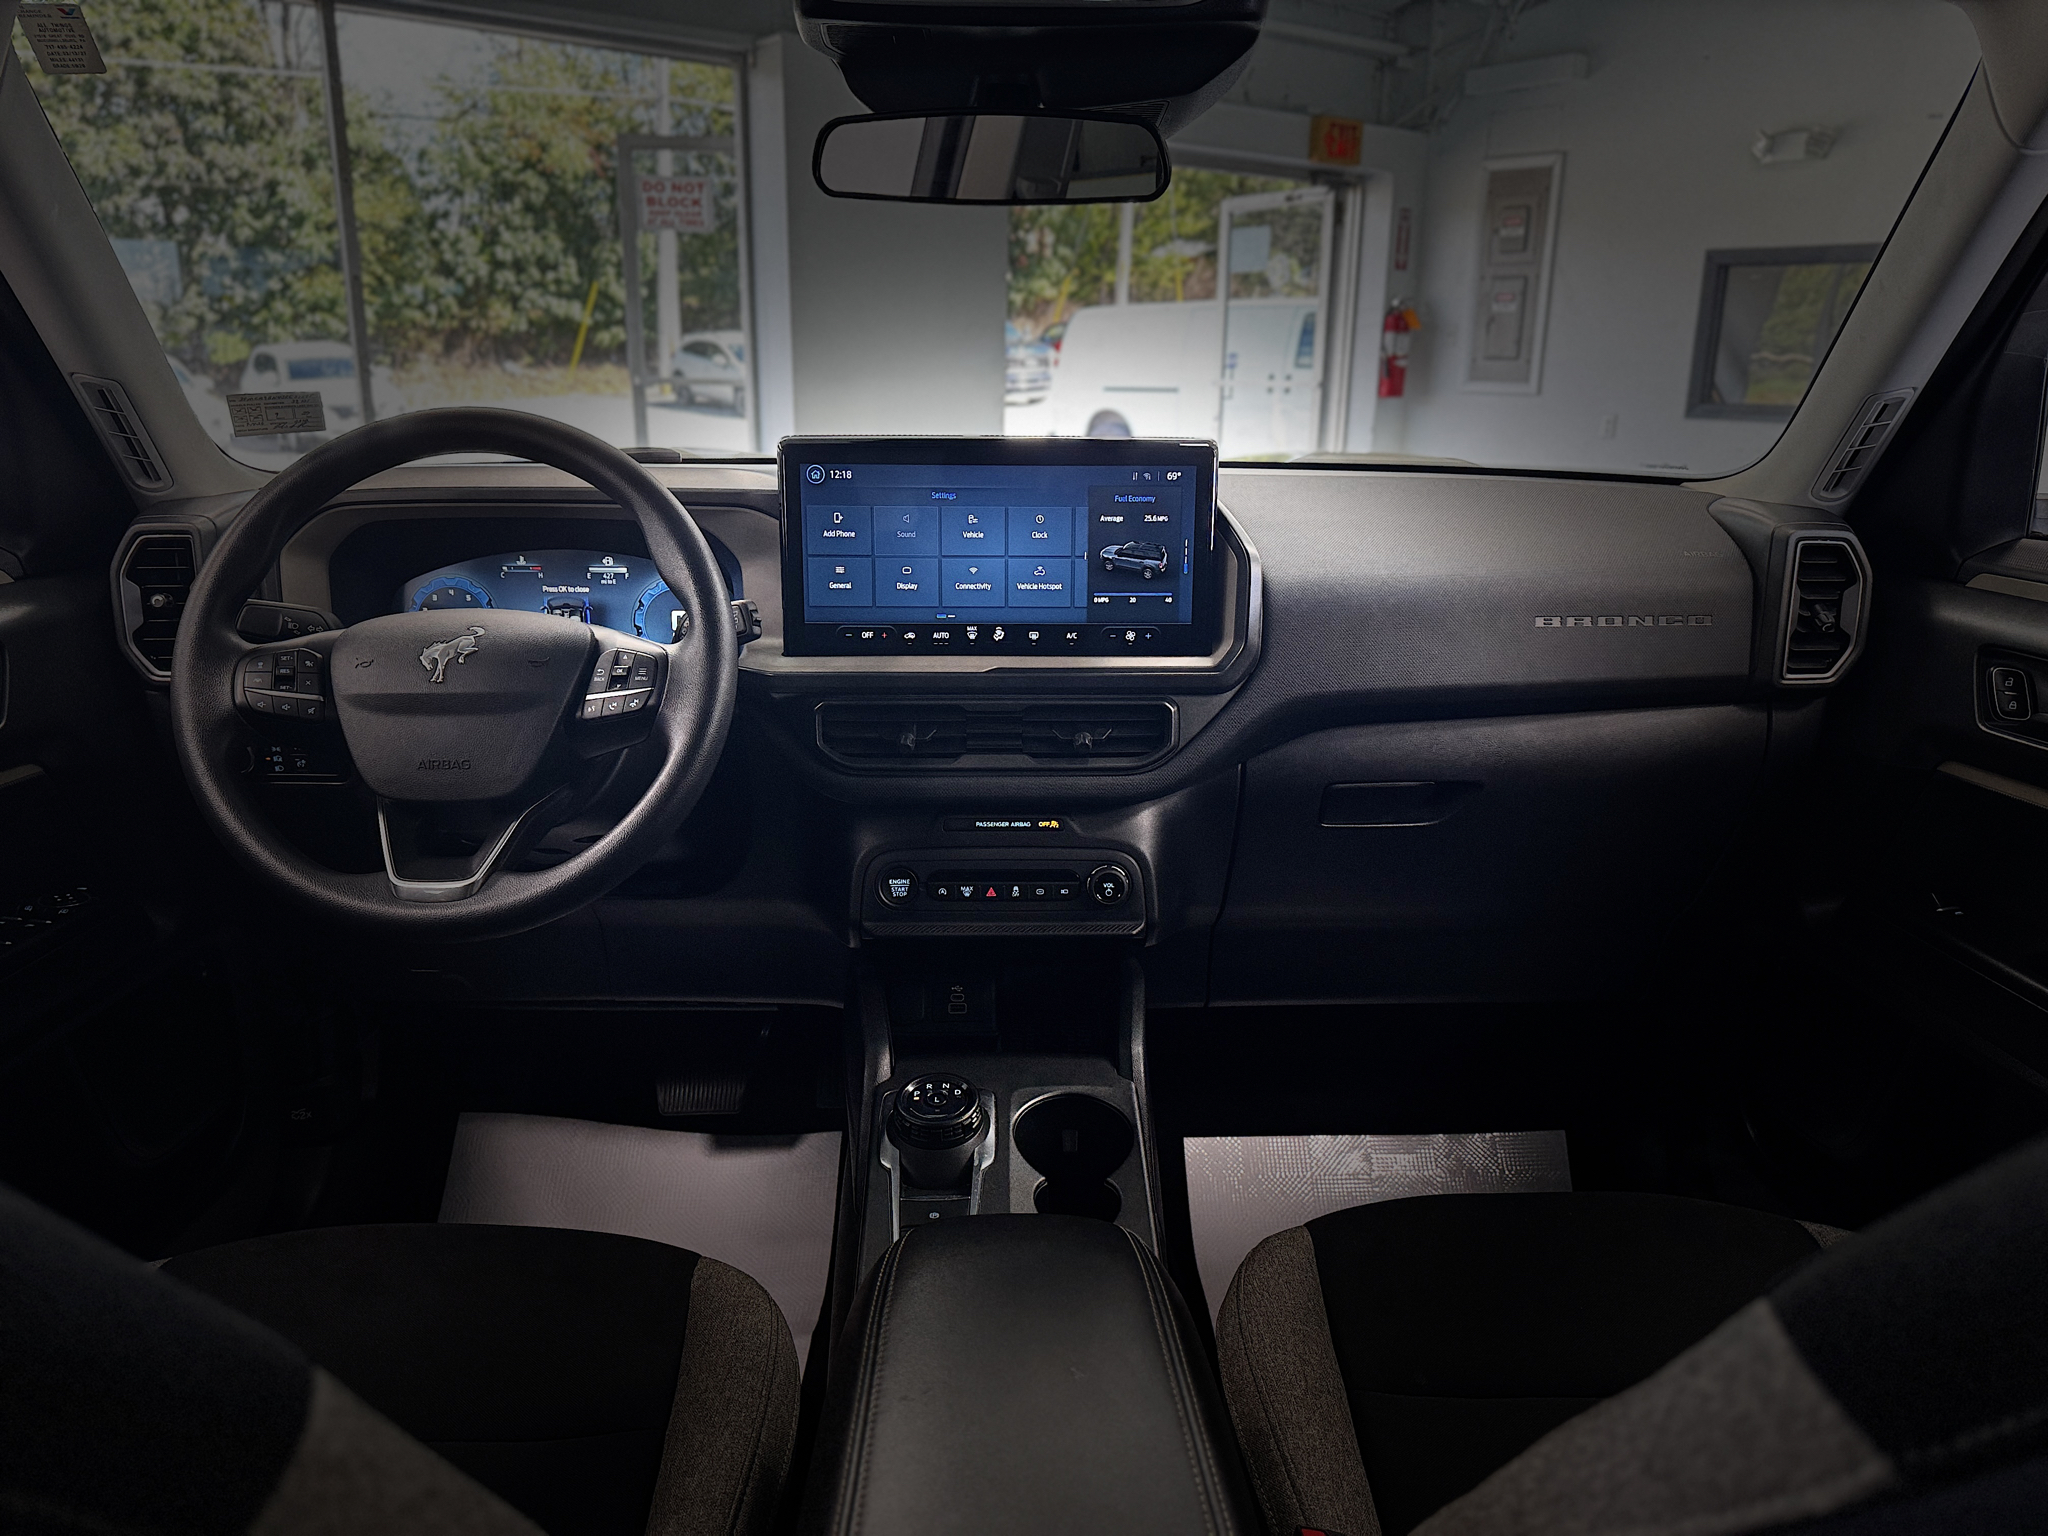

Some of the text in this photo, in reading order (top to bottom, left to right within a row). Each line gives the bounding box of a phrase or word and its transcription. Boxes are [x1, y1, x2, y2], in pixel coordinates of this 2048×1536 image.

[642, 181, 704, 194] DO NOT
[646, 196, 702, 208] BLOCK
[829, 470, 852, 480] 12:18
[1166, 472, 1182, 480] 69°
[931, 492, 957, 500] Settings
[1128, 495, 1156, 503] Economy
[1099, 515, 1124, 523] Average
[822, 530, 856, 538] Add Phone
[1031, 531, 1048, 539] Clock
[896, 582, 918, 590] Display
[955, 582, 992, 591] Connectivity
[1038, 582, 1063, 591] Hotspot
[1534, 615, 1713, 627] BRONCO
[418, 759, 471, 770] AIRBAG
